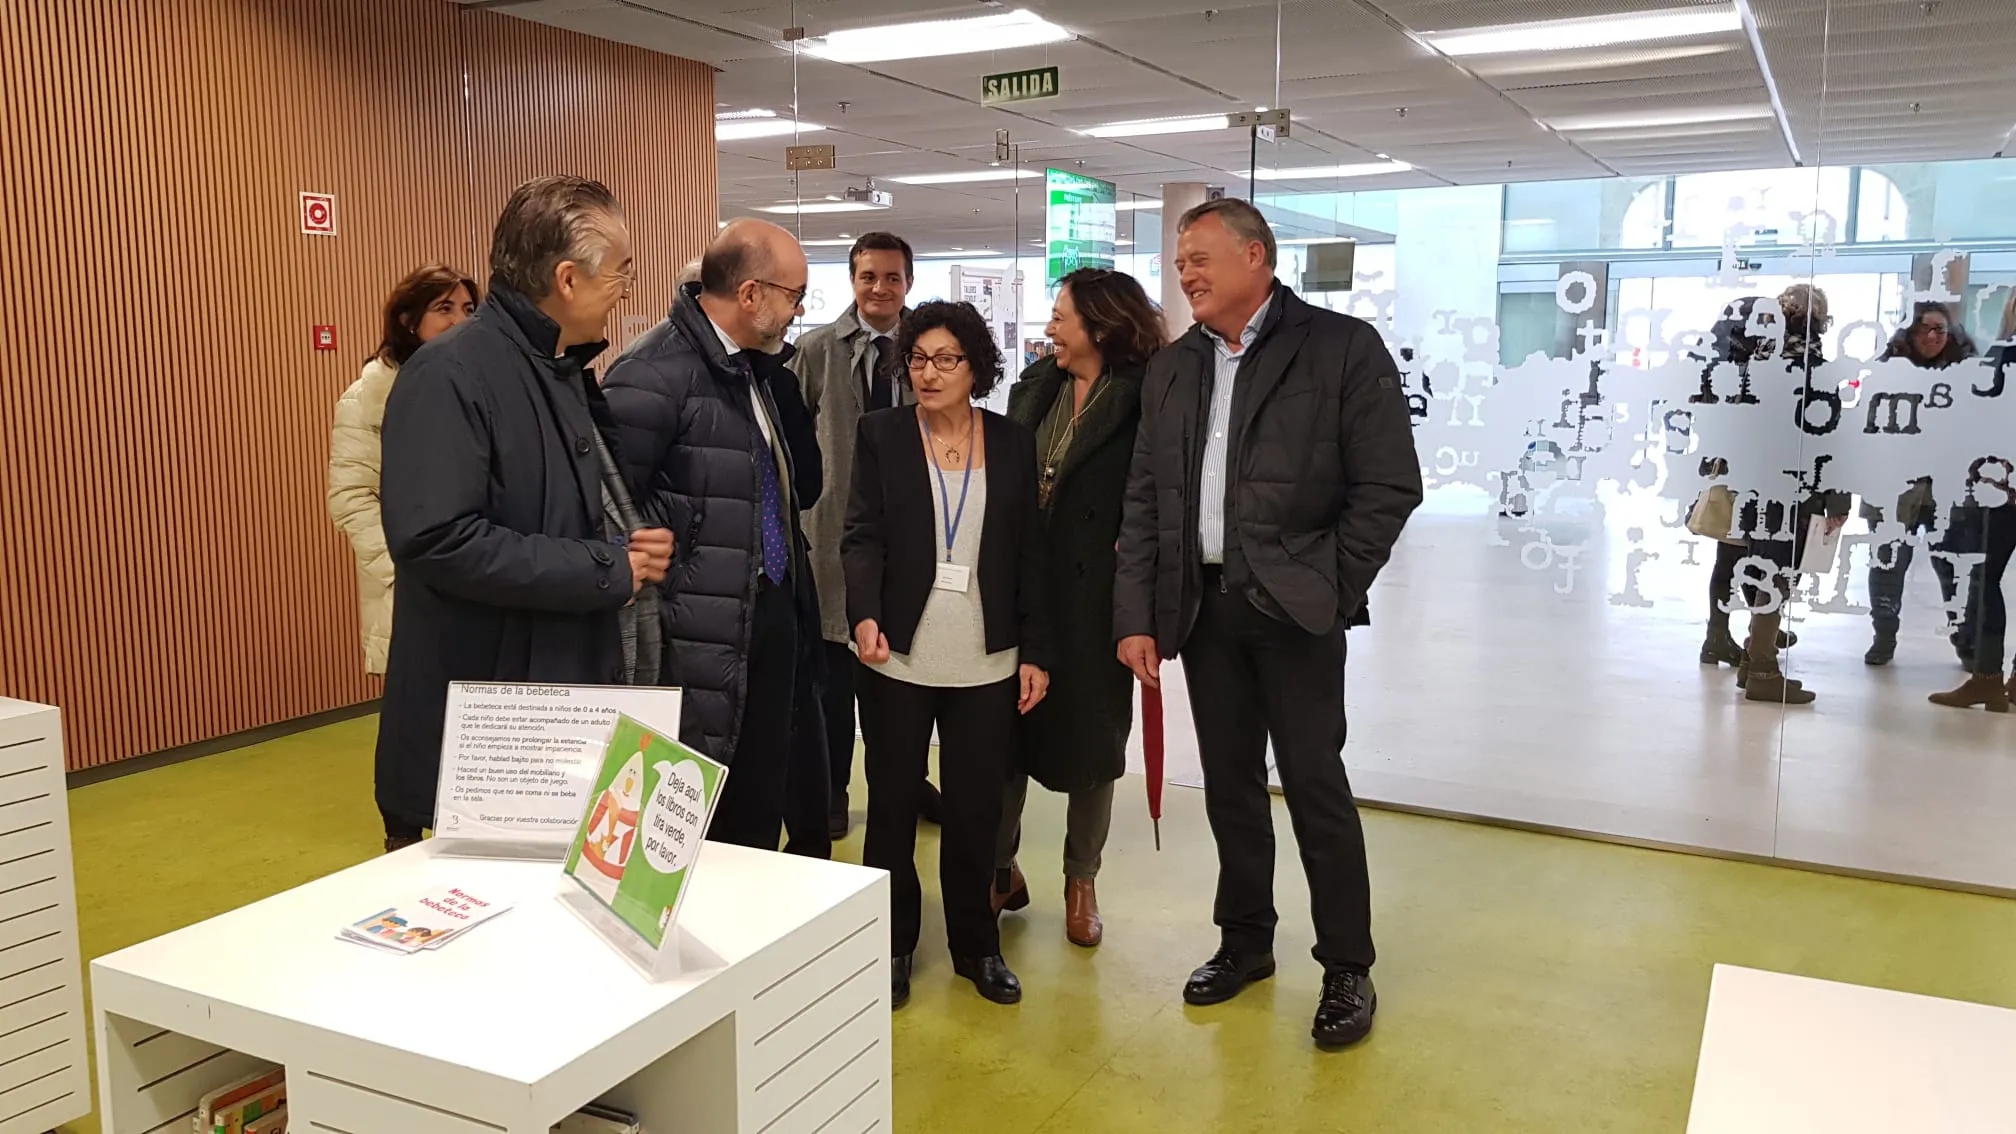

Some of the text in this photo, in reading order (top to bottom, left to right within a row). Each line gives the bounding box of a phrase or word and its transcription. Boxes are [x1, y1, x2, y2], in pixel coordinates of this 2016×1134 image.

[988, 72, 1053, 100] SALIDA
[462, 684, 570, 696] Normas de la bebeteca
[464, 700, 472, 708] La
[512, 756, 529, 764] bajito
[667, 772, 703, 803] Deja aquí
[656, 788, 698, 827] los libros con
[653, 814, 685, 848] tira verde,
[645, 837, 660, 853] por
[442, 898, 458, 906] de
[448, 888, 490, 907] Normas
[418, 898, 470, 920] bebeteca
